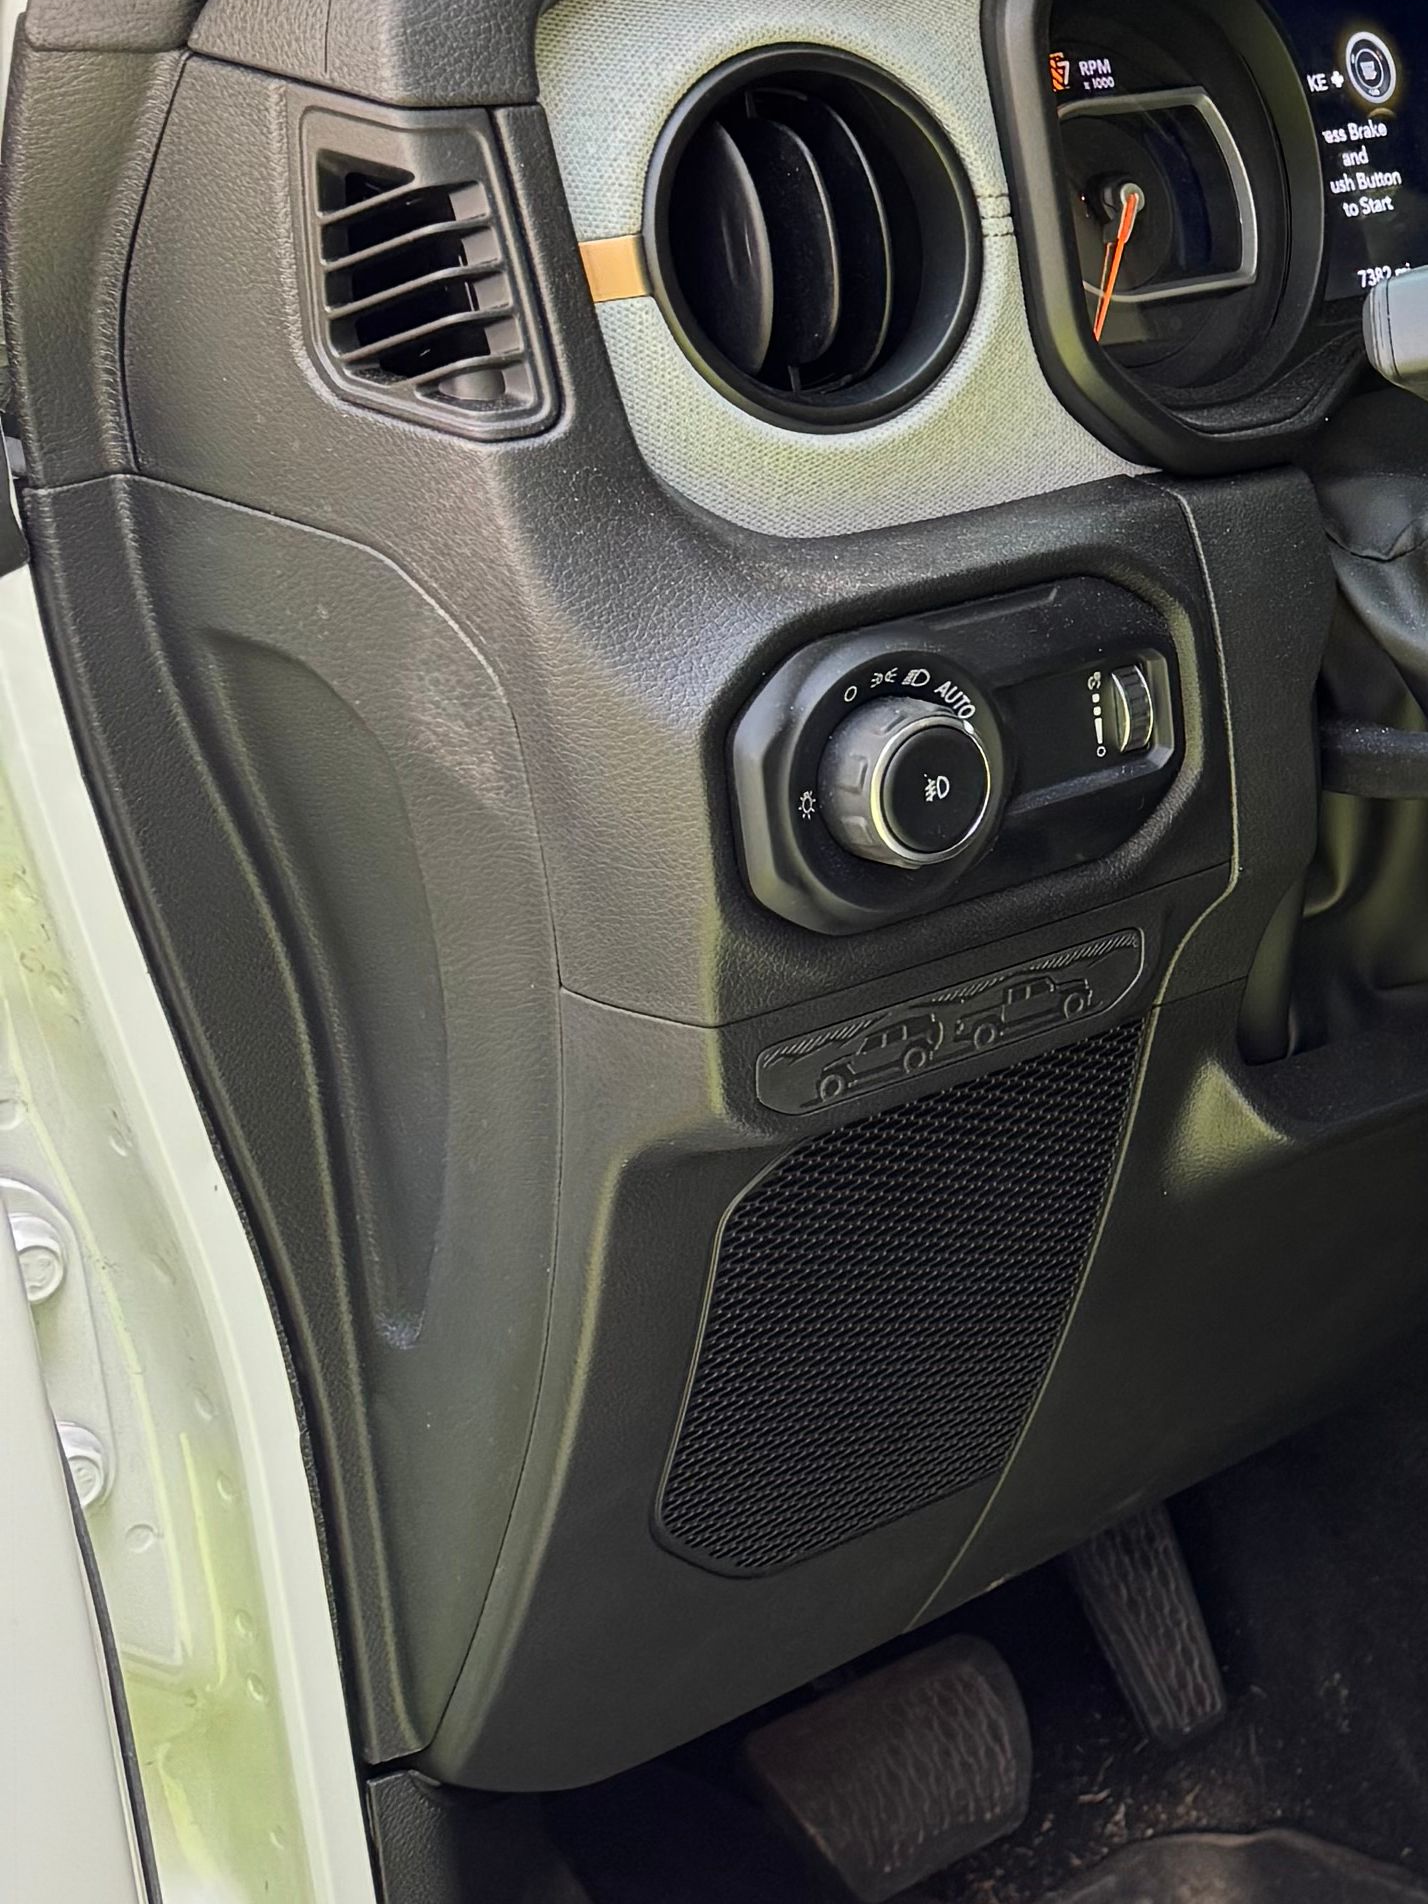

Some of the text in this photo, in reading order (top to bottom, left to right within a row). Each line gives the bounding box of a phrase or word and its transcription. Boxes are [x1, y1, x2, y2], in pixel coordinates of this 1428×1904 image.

[1079, 58, 1112, 76] RPM
[1092, 76, 1115, 90] 1000
[1322, 119, 1388, 144] ess Brake
[1342, 144, 1370, 167] and
[1355, 171, 1402, 191] Button
[1342, 196, 1394, 217] to Start
[933, 680, 976, 719] AUTO
